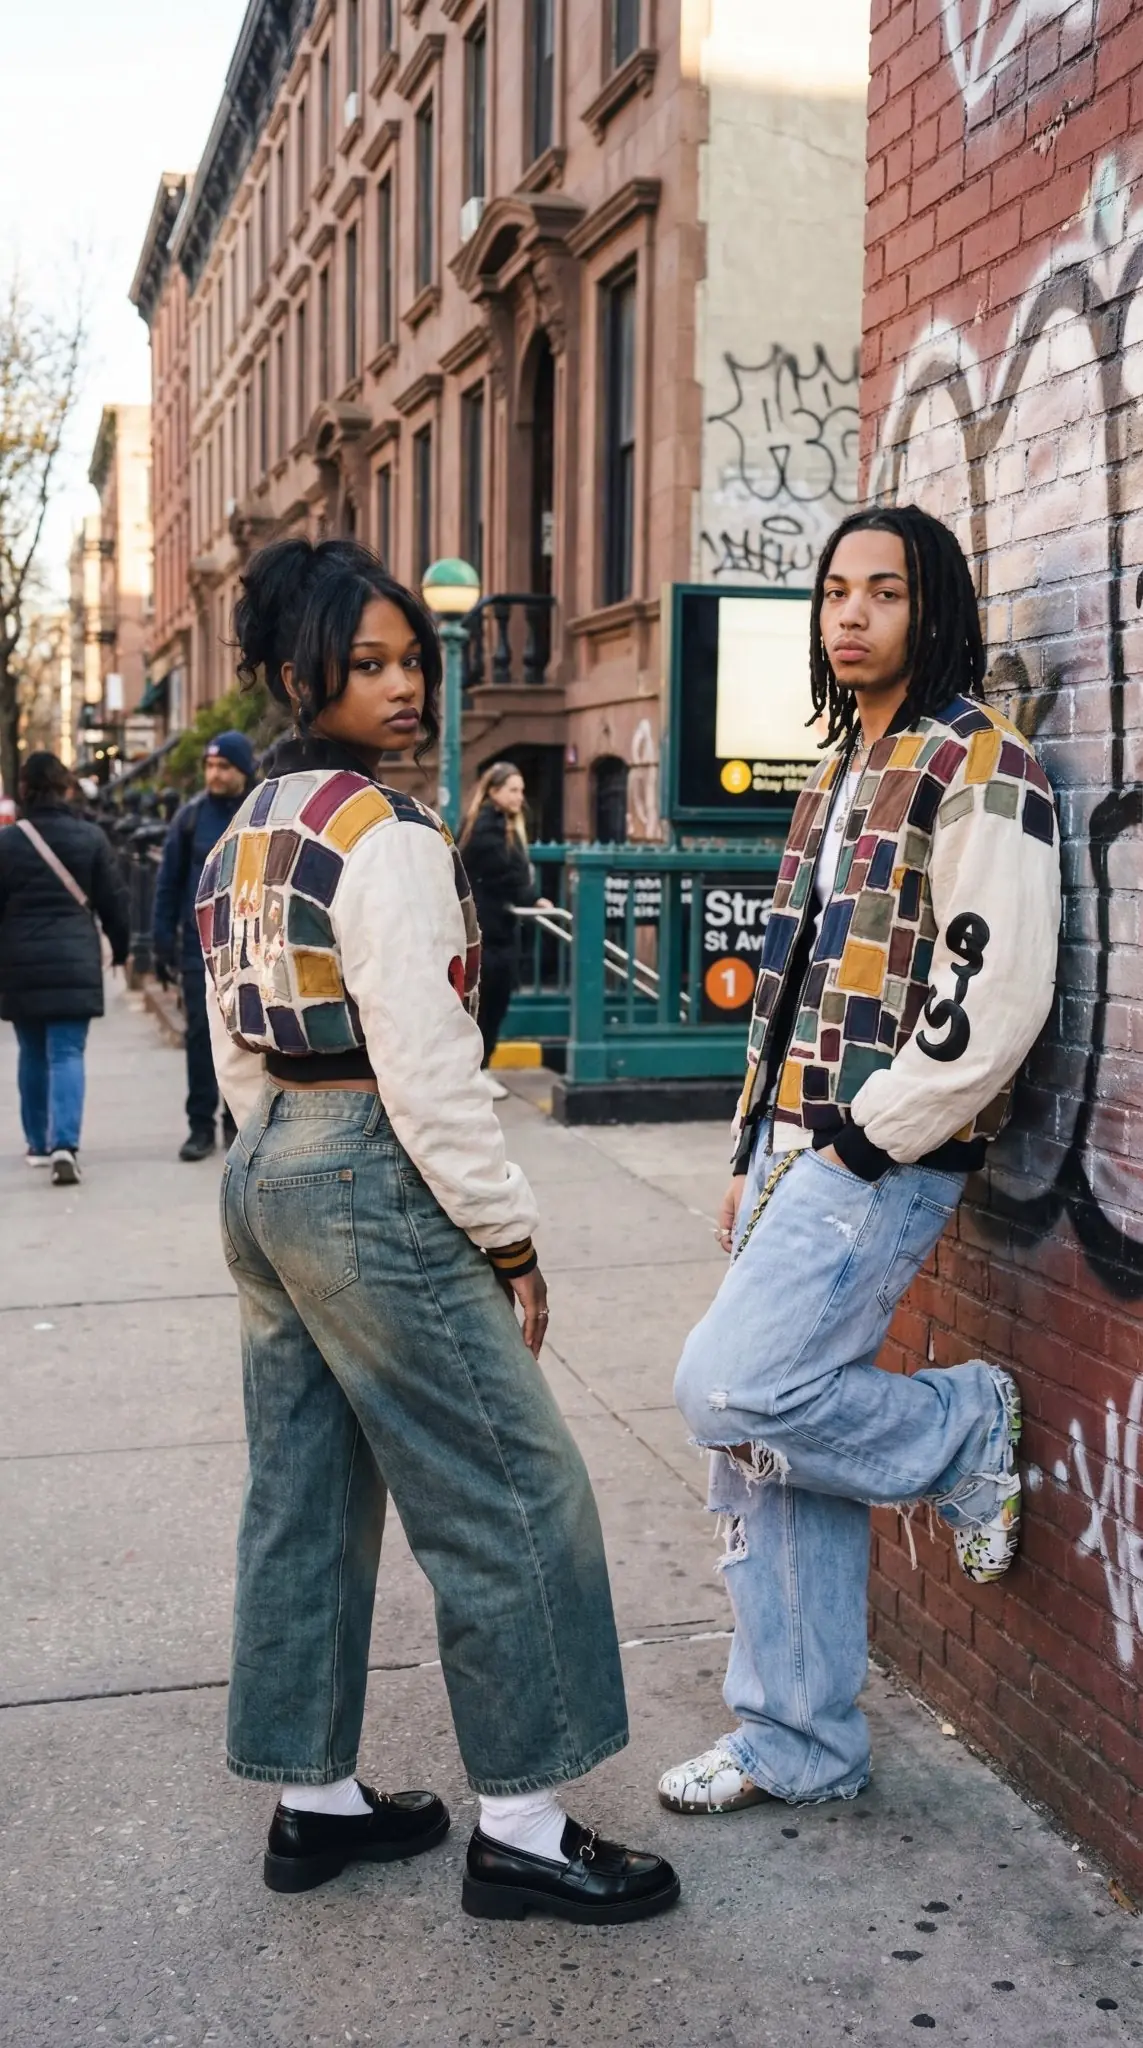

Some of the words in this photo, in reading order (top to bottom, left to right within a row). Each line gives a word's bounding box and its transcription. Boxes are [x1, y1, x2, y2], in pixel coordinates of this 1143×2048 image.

[704, 930, 729, 951] St
[734, 930, 766, 951] Av
[720, 968, 736, 998] 1
